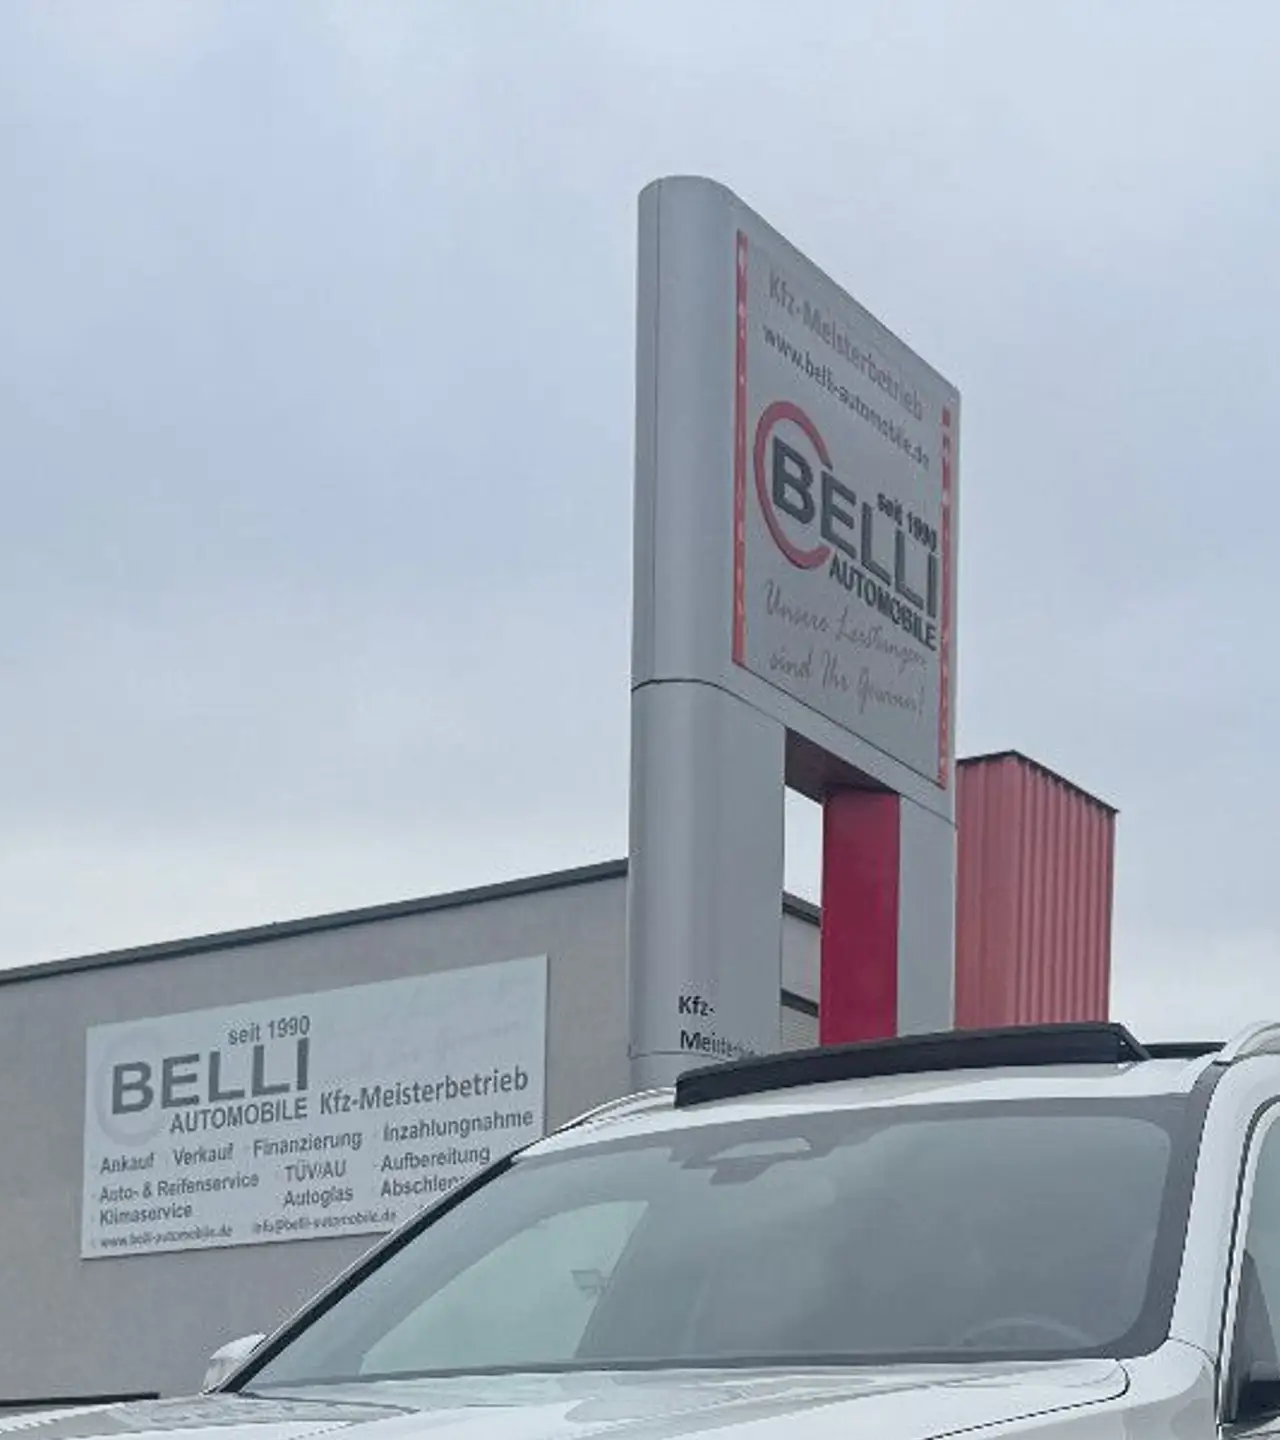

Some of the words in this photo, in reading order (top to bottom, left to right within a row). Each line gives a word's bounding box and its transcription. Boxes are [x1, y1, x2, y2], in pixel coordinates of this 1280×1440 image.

[773, 436, 938, 618] BELLI
[878, 493, 903, 526] seit
[907, 512, 938, 552] 1990
[830, 553, 938, 651] AUTOMOBILE
[228, 1022, 261, 1045] seit
[269, 1015, 311, 1039] 1990
[678, 995, 716, 1017] Kfz-
[112, 1037, 310, 1115] BELLI
[320, 1065, 529, 1115] Kfz-Meisterbetrieb
[100, 1152, 155, 1175] Ankauf
[173, 1142, 234, 1166] Verkauf
[253, 1131, 363, 1158] Finanzierung
[383, 1109, 534, 1142] Inzahlungnahme
[170, 1097, 308, 1134] AUTOMOBILE
[100, 1185, 139, 1203] Auto-
[142, 1181, 153, 1200] &
[157, 1173, 260, 1198] Reifenservice
[381, 1147, 491, 1173] Aufbereitung
[100, 1202, 193, 1226] Klimaservice
[283, 1185, 354, 1209] Autoglas
